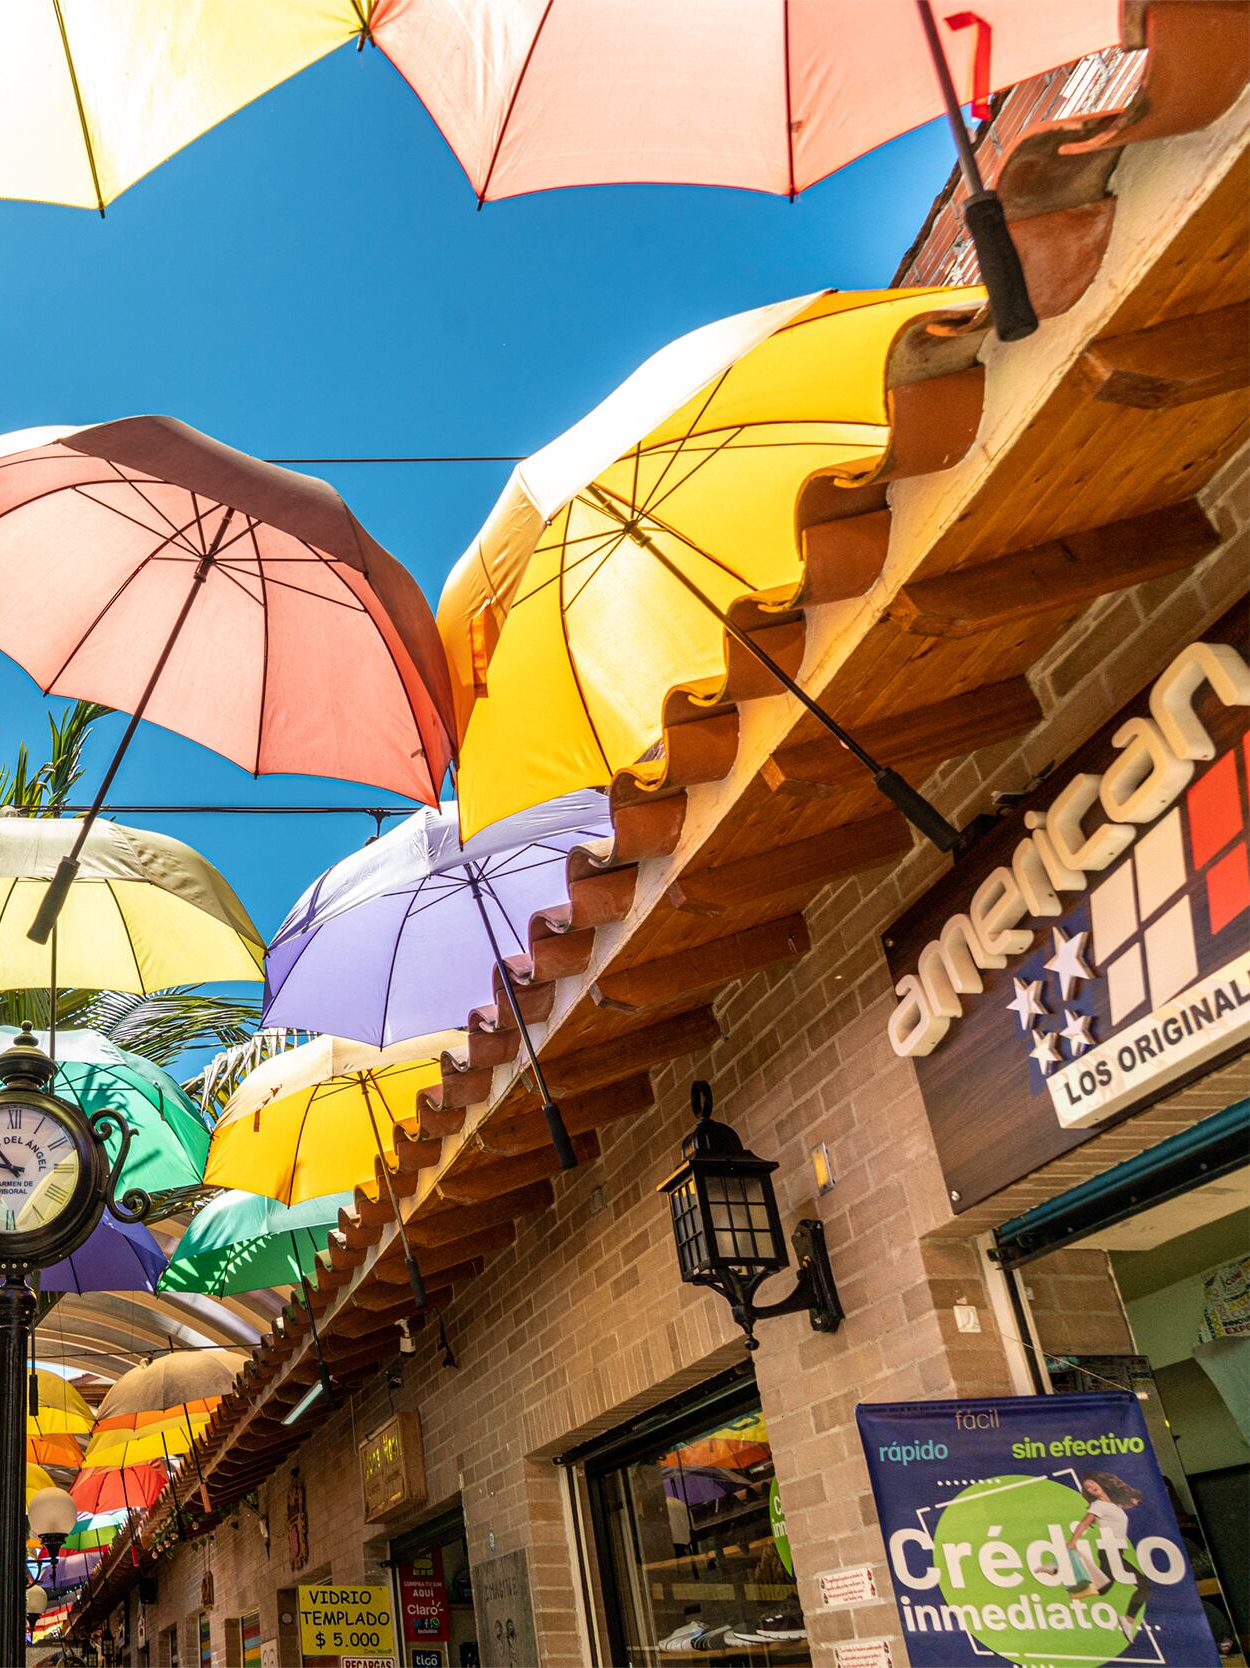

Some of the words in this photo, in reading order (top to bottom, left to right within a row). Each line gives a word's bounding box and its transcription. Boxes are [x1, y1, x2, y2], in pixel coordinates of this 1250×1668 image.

[888, 642, 1250, 1057] american
[1064, 1060, 1112, 1105] LOS
[1117, 970, 1250, 1072] ORIGINAL
[3, 1136, 23, 1145] DEL
[955, 1409, 1000, 1430] fácil
[879, 1440, 948, 1466] rápido
[1012, 1437, 1046, 1459] sin
[1049, 1433, 1145, 1457] efectivo
[889, 1524, 1186, 1590] Crédito
[309, 1591, 371, 1605] VIDRIO
[407, 1602, 440, 1615] Claro
[301, 1611, 390, 1626] TEMPLADO
[316, 1631, 326, 1649] $
[333, 1633, 380, 1648] 5.000
